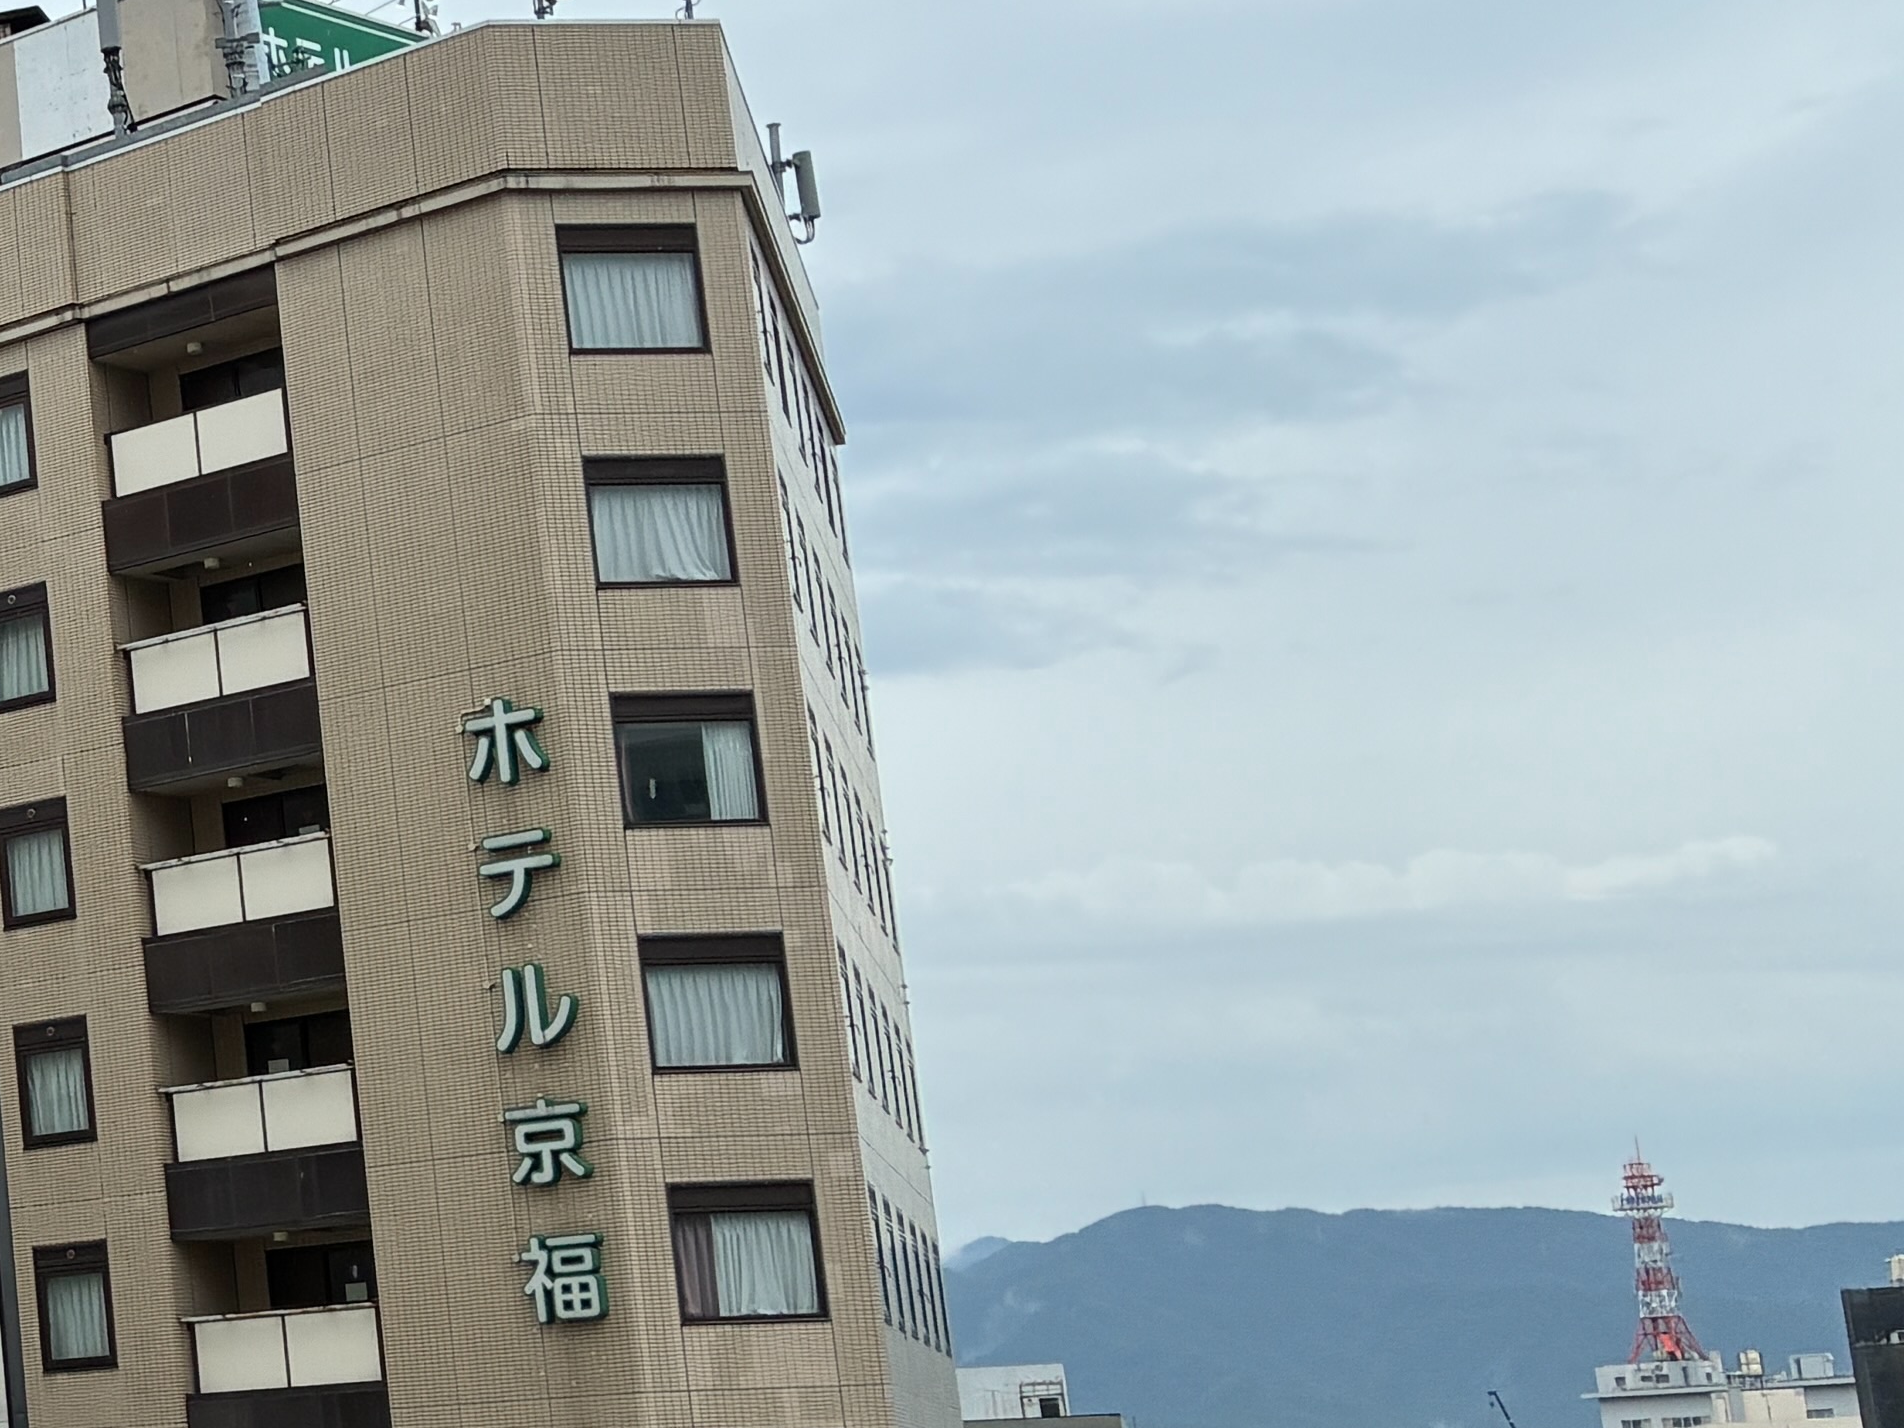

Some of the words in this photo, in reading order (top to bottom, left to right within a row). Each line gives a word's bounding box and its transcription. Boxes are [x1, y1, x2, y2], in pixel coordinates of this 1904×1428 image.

[462, 697, 609, 1325] ホテル京福
